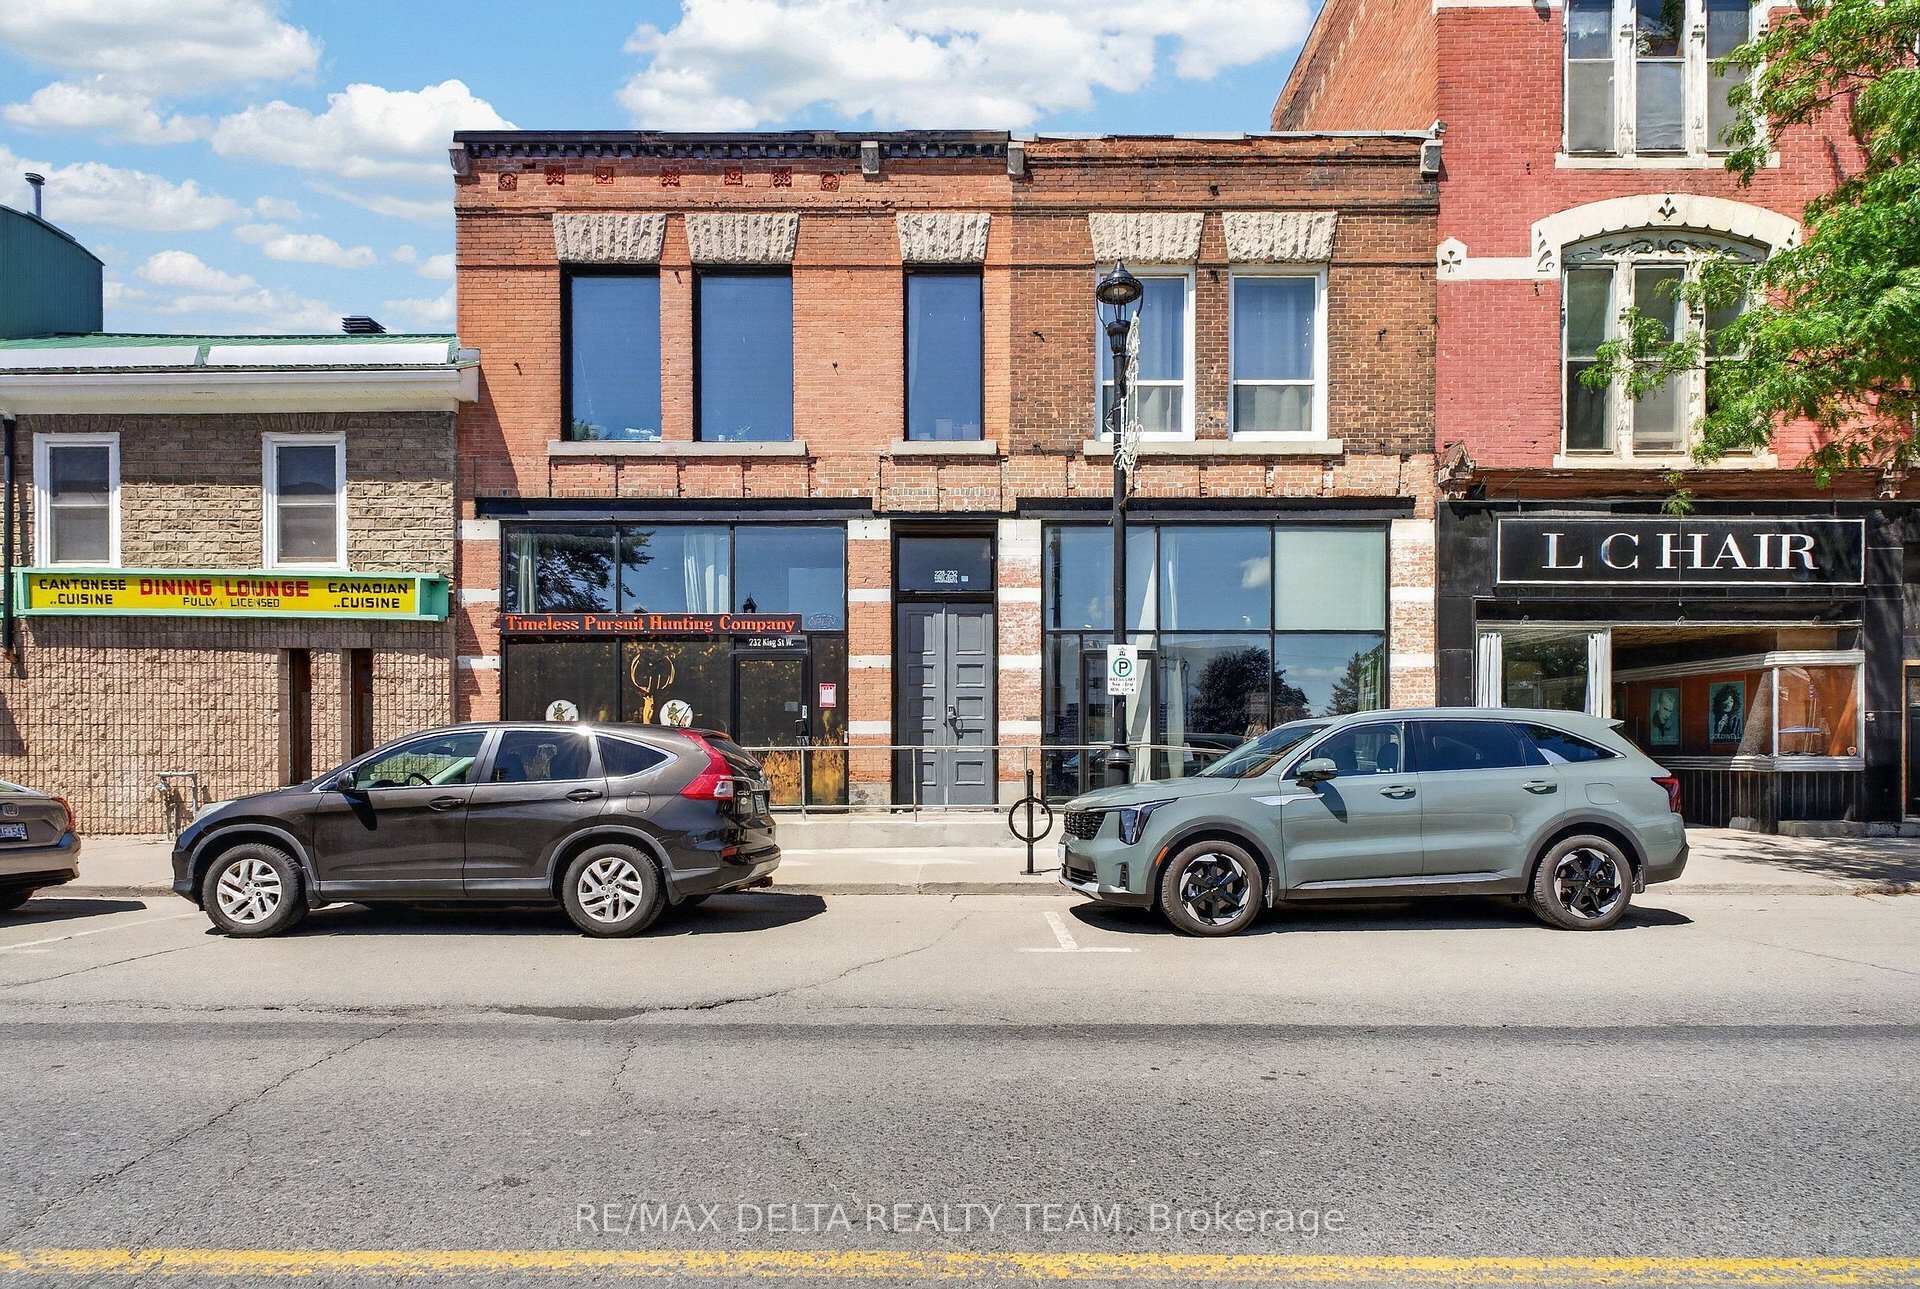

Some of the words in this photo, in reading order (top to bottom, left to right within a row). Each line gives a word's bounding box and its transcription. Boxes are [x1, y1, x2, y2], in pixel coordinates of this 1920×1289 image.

[1542, 533, 1584, 569] L
[1600, 533, 1639, 569] C
[1655, 533, 1819, 570] HAIR
[39, 579, 126, 591] CANTONESE
[139, 579, 212, 596] DINING
[224, 580, 309, 597] LOUNGE
[328, 583, 408, 595] CANADIAN
[183, 597, 217, 607] FULLY
[506, 614, 580, 631] Timeless
[584, 614, 645, 631] Pursuit
[649, 614, 714, 633] Hunting
[719, 615, 796, 633] Company
[748, 638, 761, 647] 232
[762, 638, 776, 648] King
[777, 639, 785, 647] St
